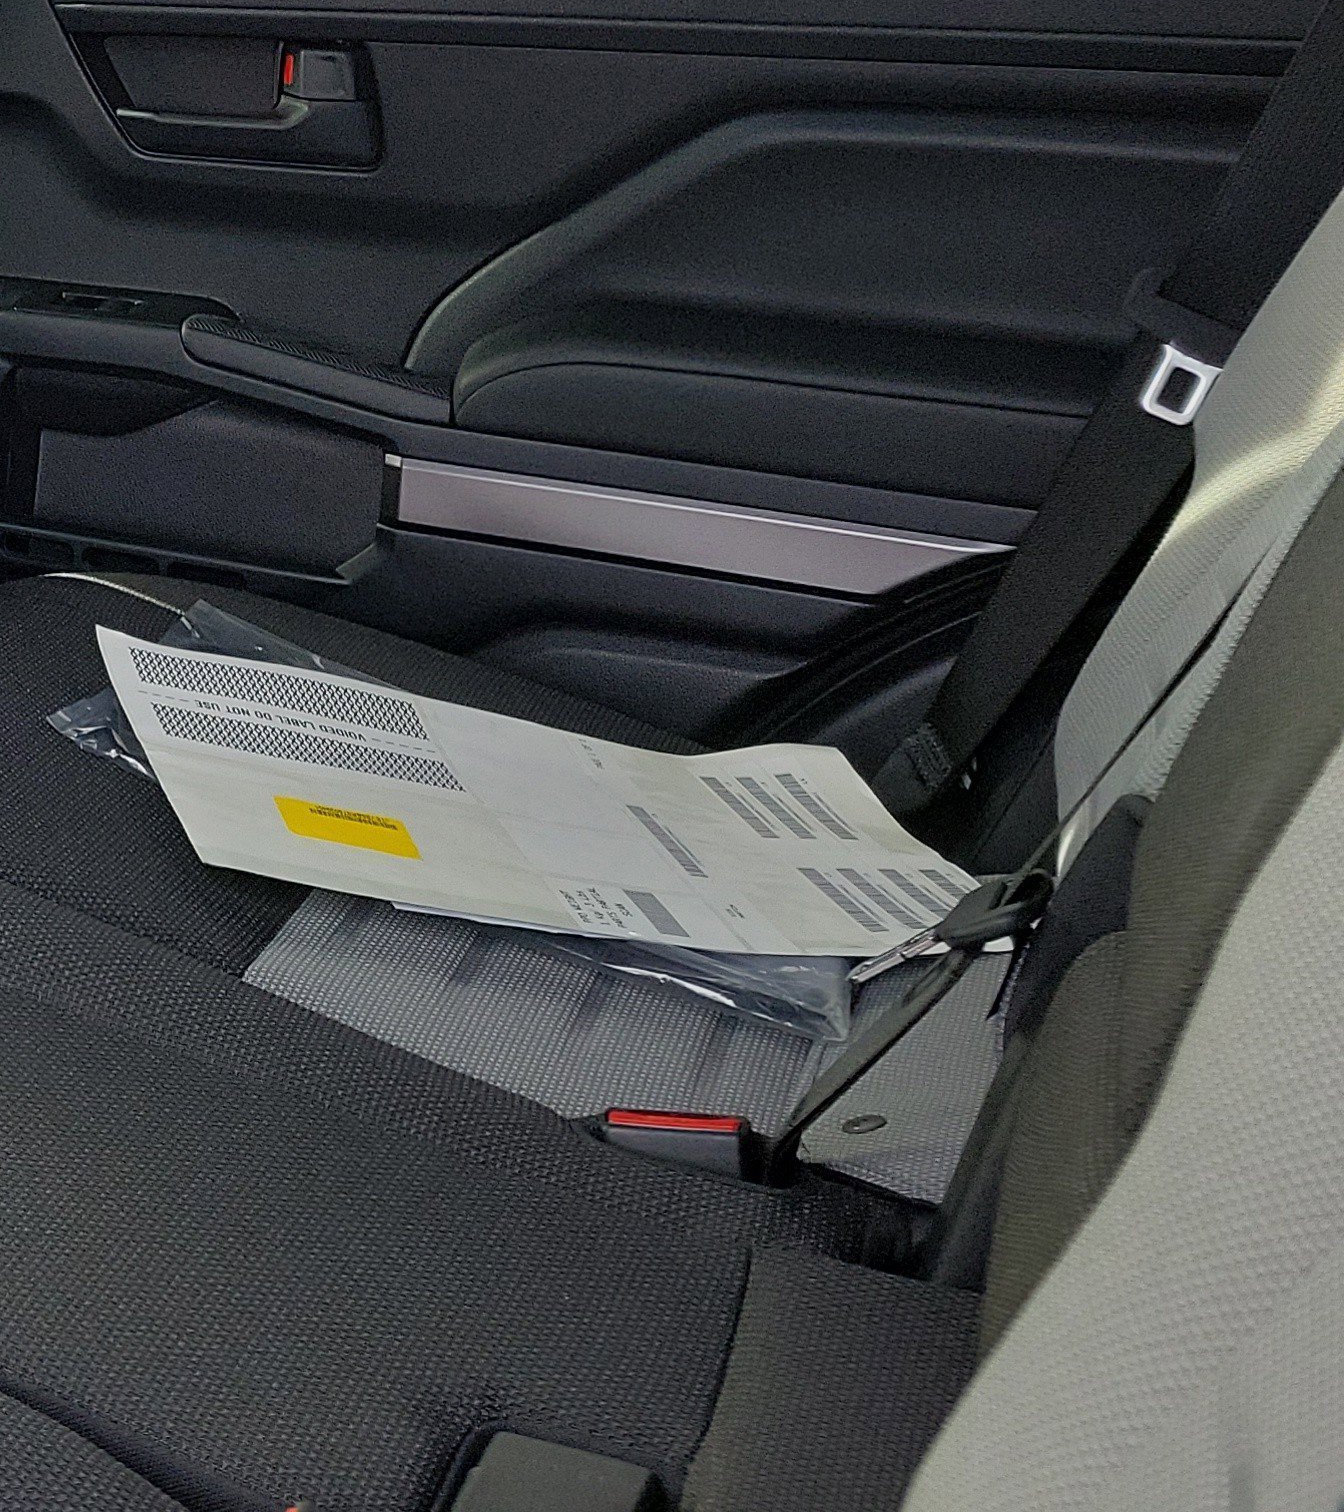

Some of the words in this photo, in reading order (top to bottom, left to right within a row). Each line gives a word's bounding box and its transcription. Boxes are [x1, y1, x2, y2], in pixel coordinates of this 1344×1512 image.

[194, 698, 221, 713] USE
[224, 705, 251, 718] NOT
[254, 710, 272, 722] DO
[274, 714, 316, 732] LABEL
[318, 723, 367, 742] VOIDED
